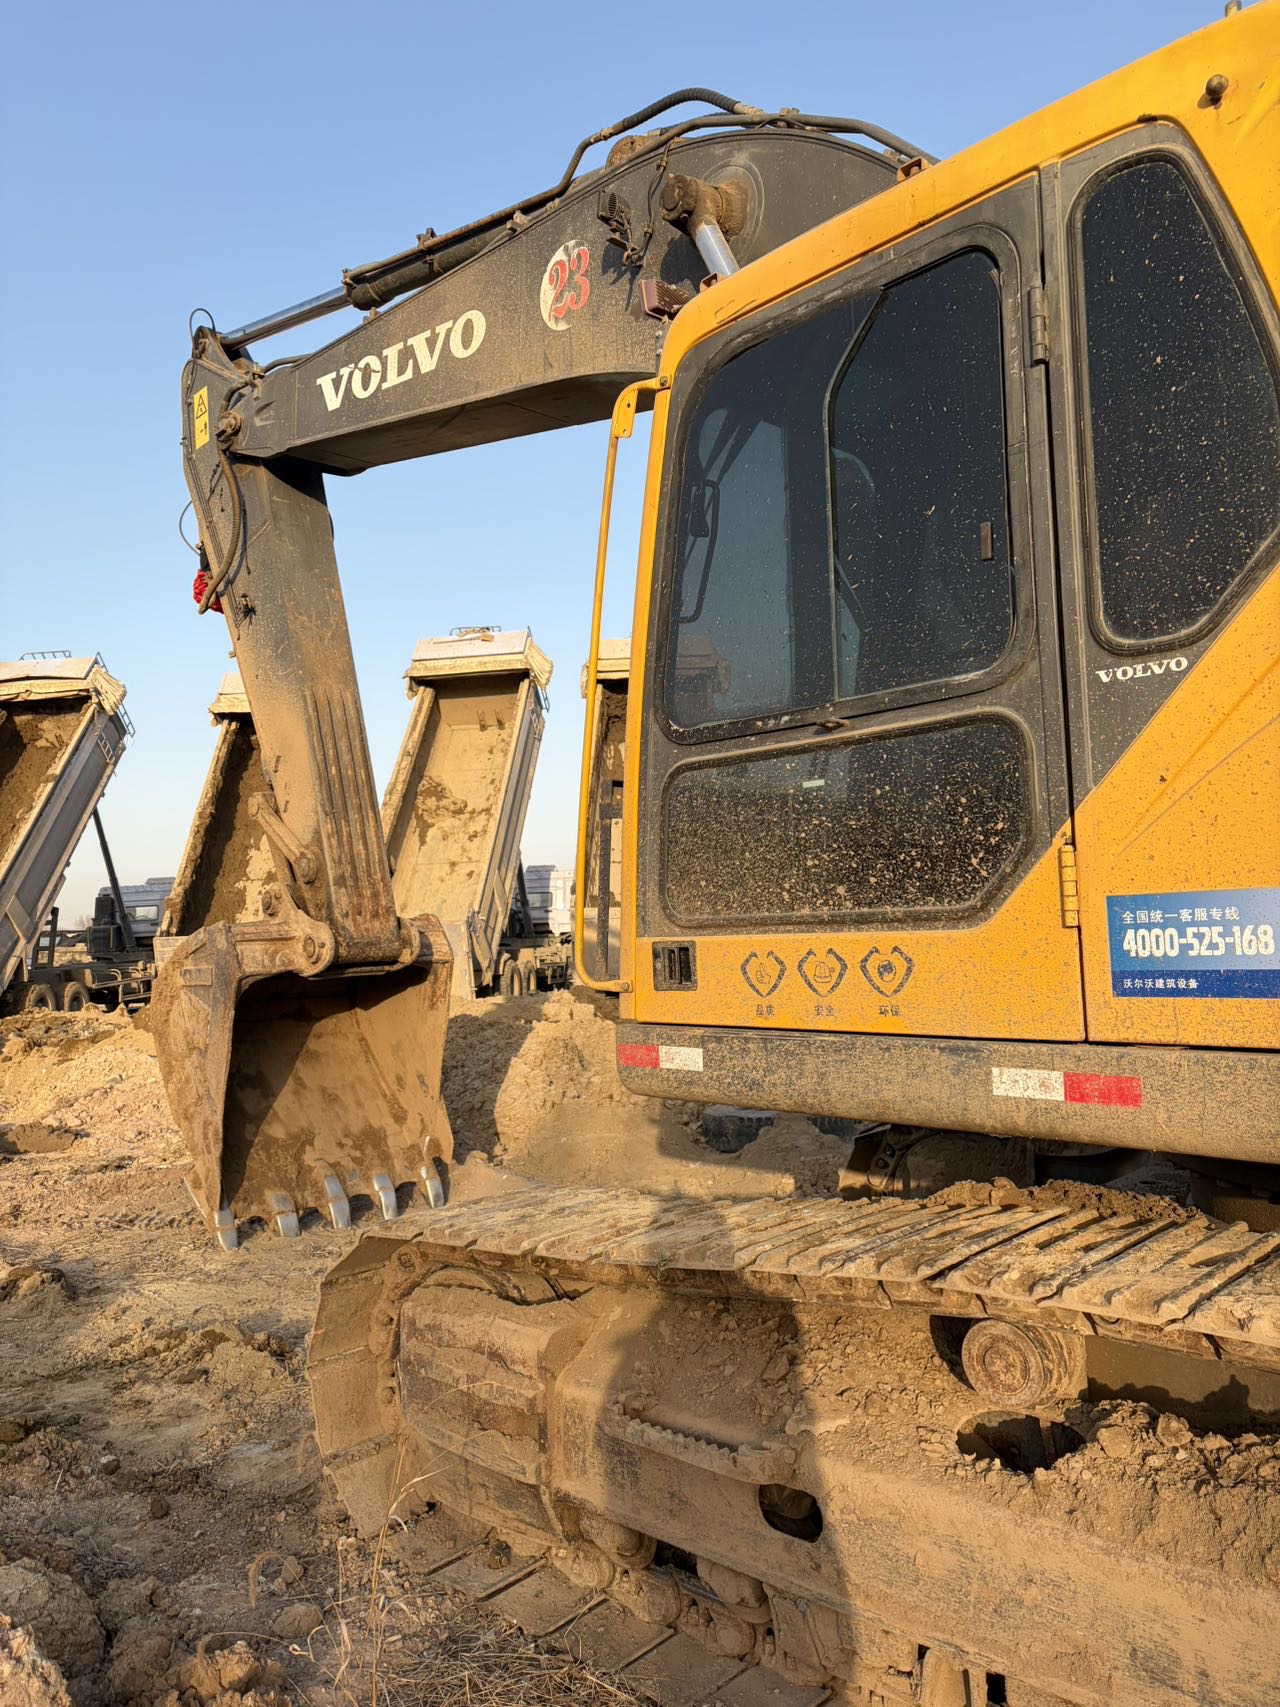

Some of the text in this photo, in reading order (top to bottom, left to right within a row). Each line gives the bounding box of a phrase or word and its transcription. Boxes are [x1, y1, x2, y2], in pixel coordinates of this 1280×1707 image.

[548, 248, 590, 321] 23
[316, 309, 487, 412] VOLVO
[1095, 656, 1188, 683] VOLVO
[1122, 906, 1240, 925] 全国统一客服专线
[1122, 924, 1275, 958] 4000-525-168
[1123, 978, 1199, 989] 沃尔沃建筑设备
[755, 1004, 775, 1016] 品质
[814, 1004, 835, 1016] 安全
[878, 1004, 901, 1017] 环保
